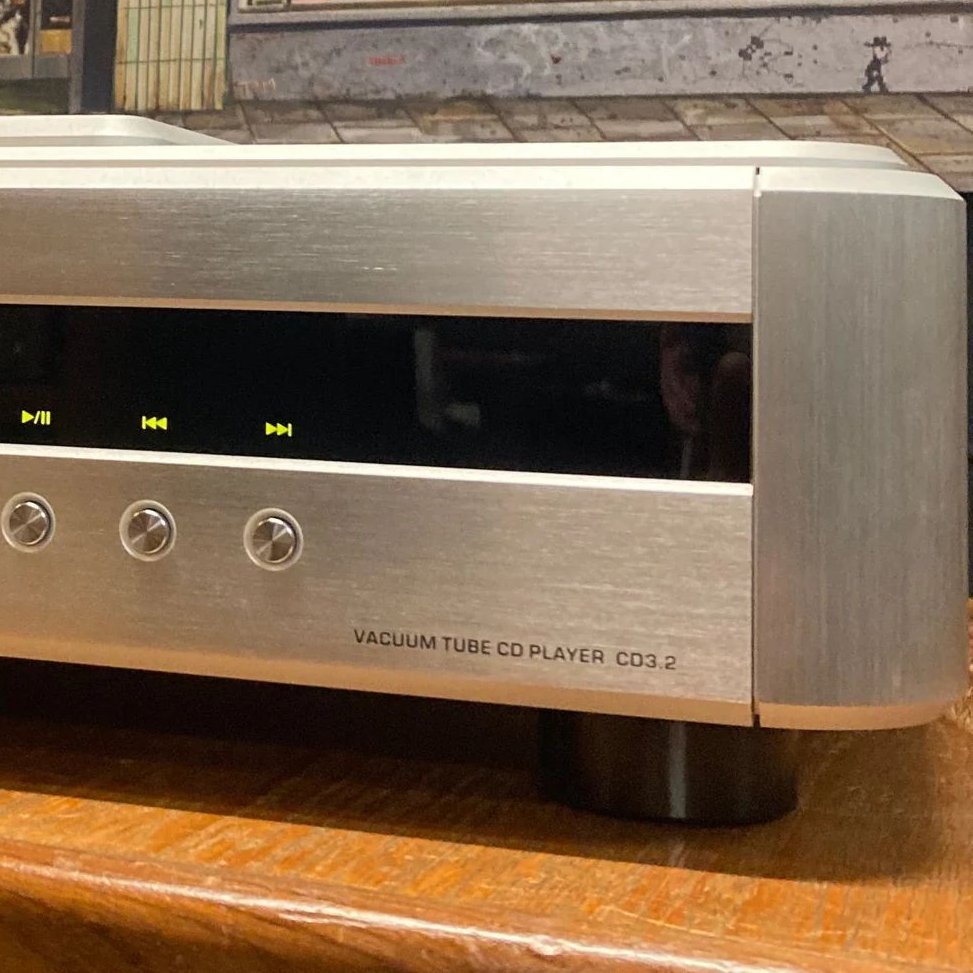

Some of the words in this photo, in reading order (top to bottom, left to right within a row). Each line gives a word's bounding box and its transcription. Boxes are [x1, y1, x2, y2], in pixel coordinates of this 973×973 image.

[353, 629, 437, 650] VACUUM
[441, 636, 491, 656] TUBE
[496, 641, 525, 658] CD
[528, 643, 605, 665] PLAYER
[615, 650, 677, 671] CD3.2
